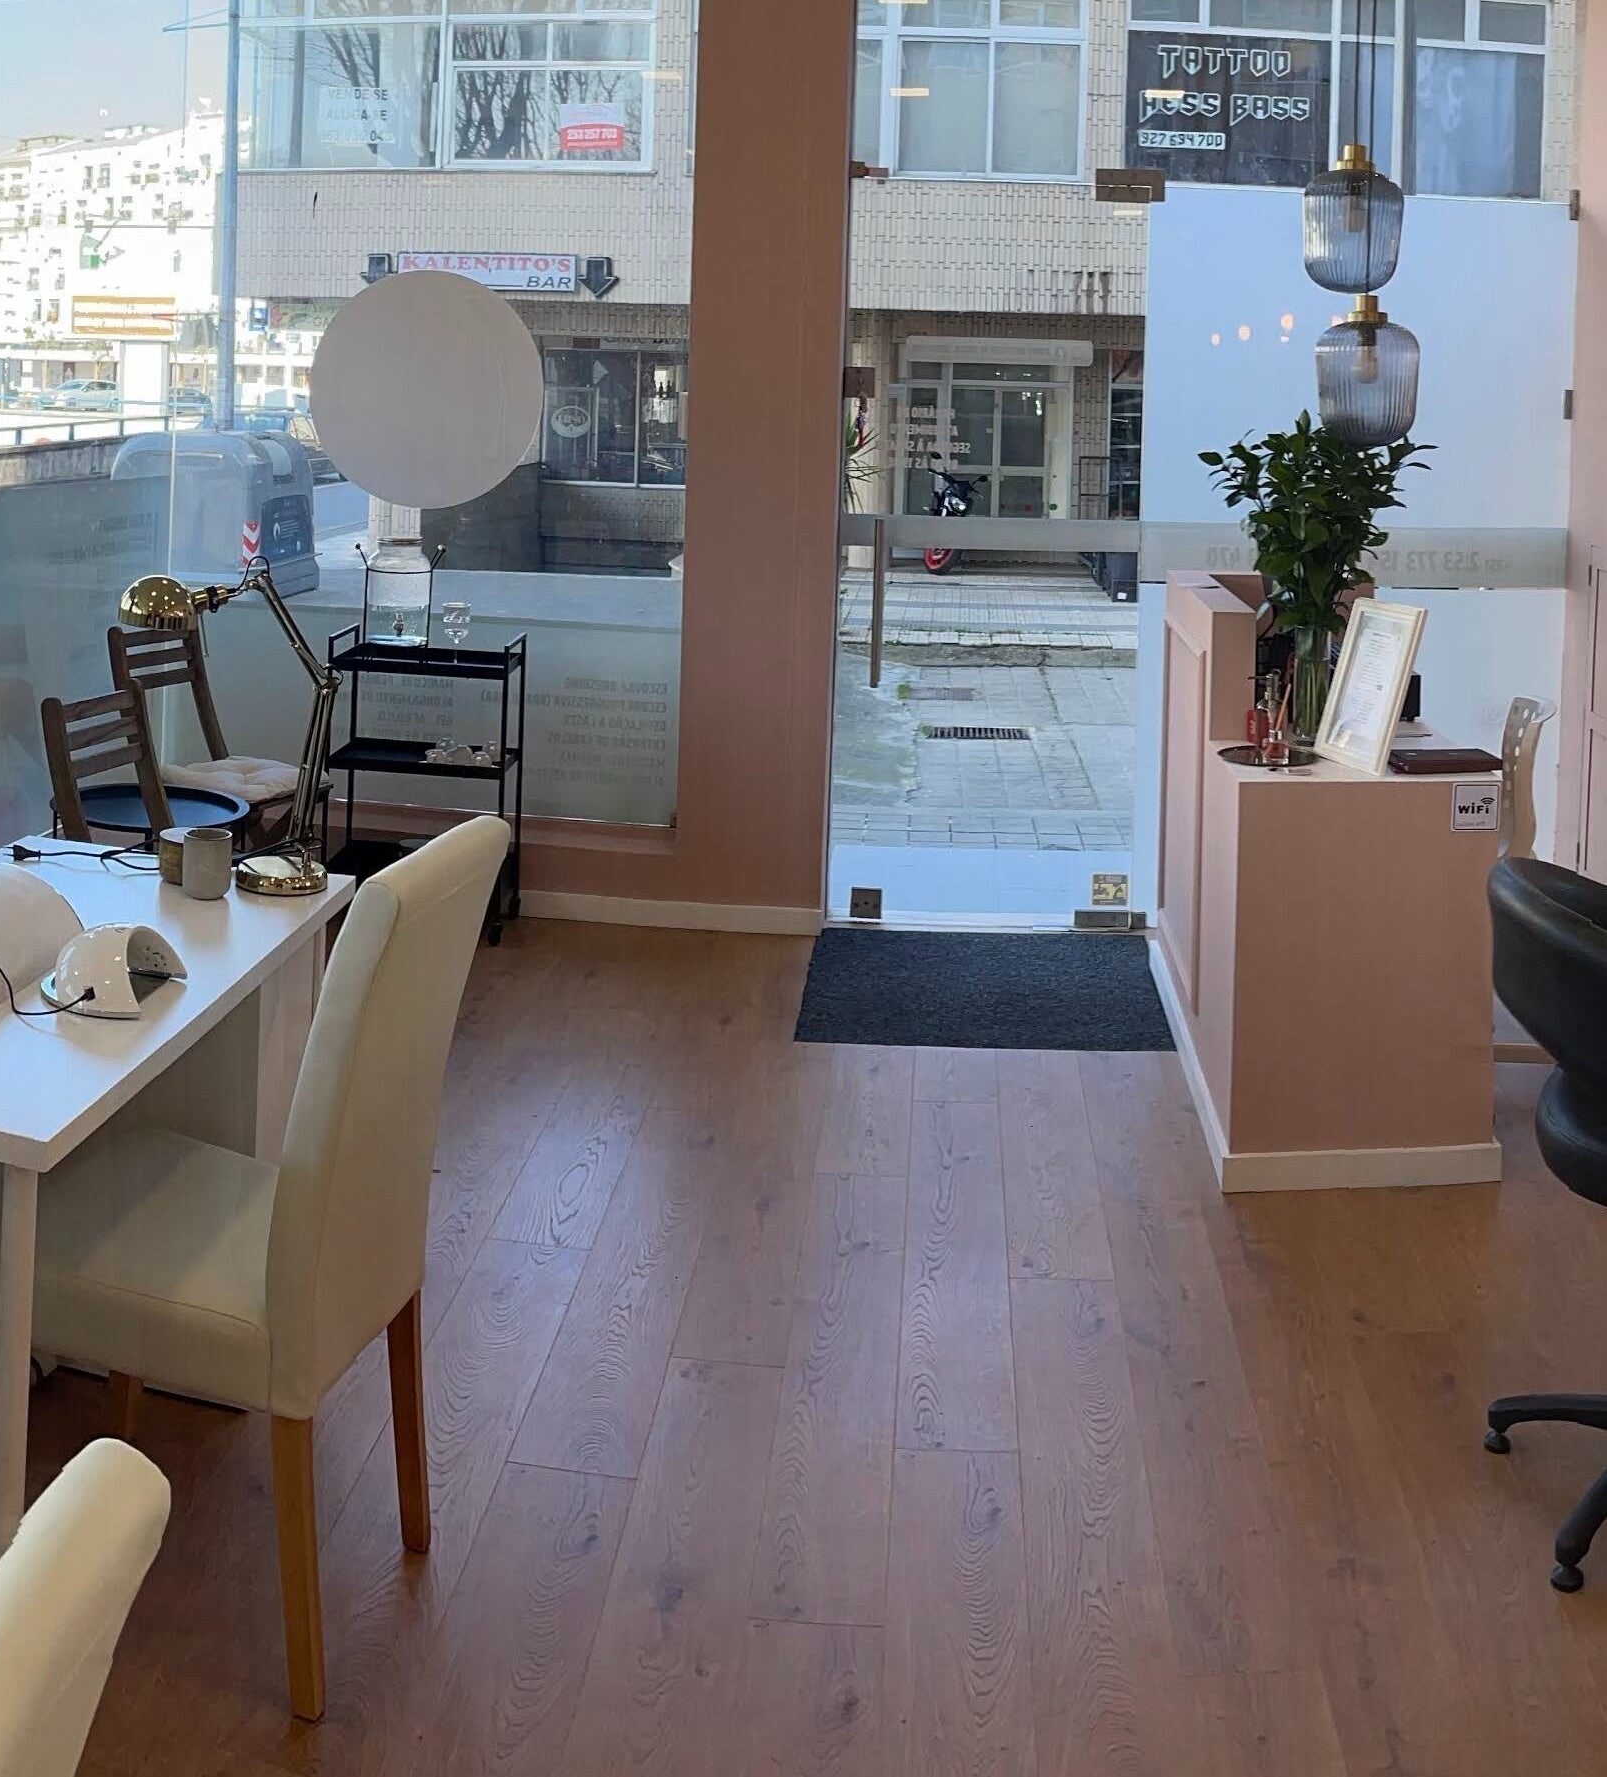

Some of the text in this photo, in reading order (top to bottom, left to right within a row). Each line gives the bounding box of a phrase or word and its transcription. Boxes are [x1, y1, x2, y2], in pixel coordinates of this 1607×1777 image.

[1156, 44, 1291, 79] TATTOO
[1229, 94, 1310, 126] BASS
[1198, 134, 1223, 147] 700
[402, 255, 571, 273] KALENTITO'S
[526, 276, 571, 289] BAR
